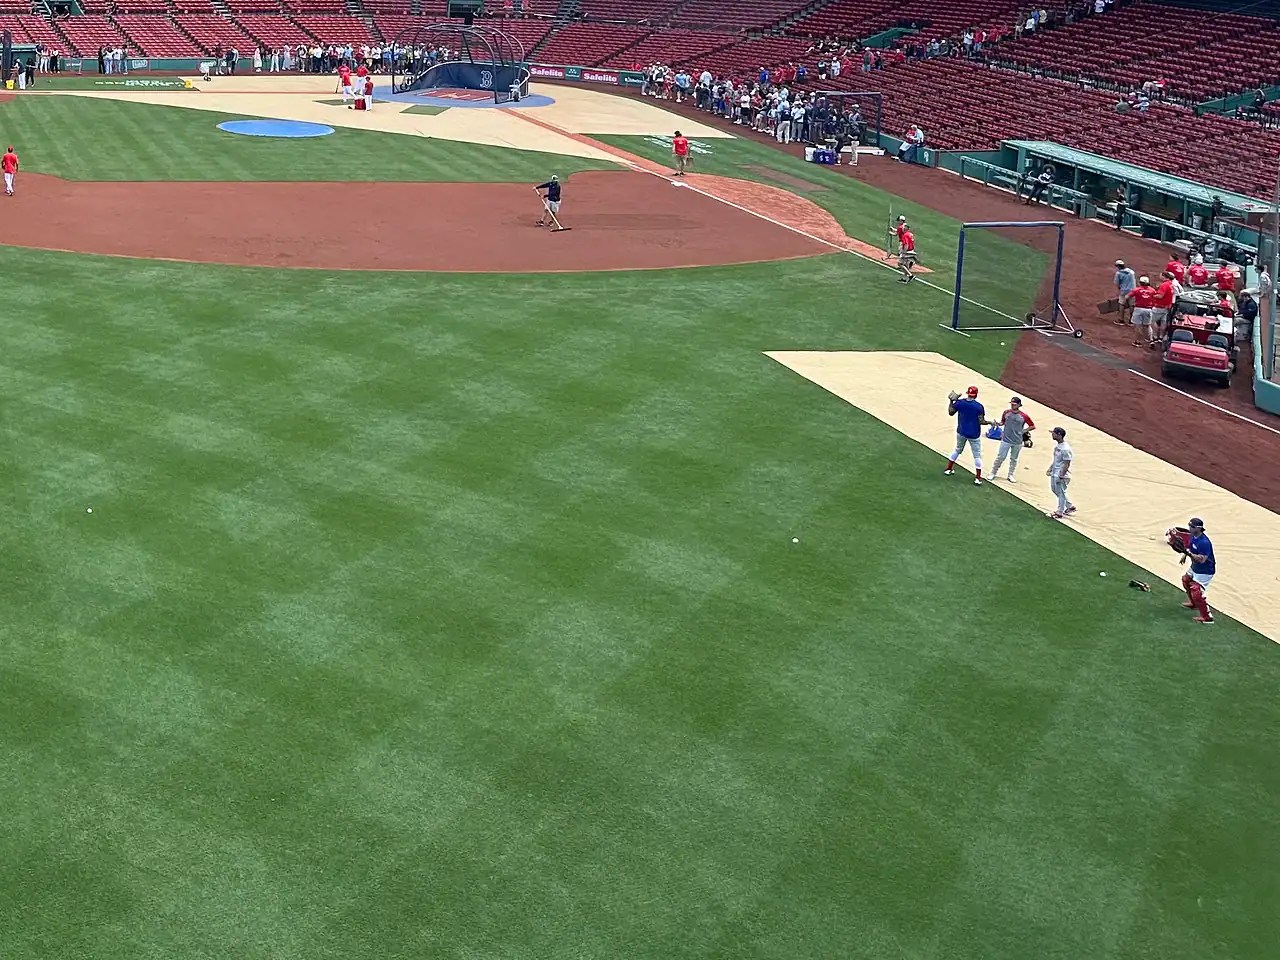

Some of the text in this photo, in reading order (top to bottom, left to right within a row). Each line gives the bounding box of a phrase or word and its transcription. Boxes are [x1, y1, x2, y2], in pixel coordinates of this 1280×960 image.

[530, 67, 563, 77] Safelite
[583, 72, 617, 83] Safelite
[480, 70, 493, 88] B
